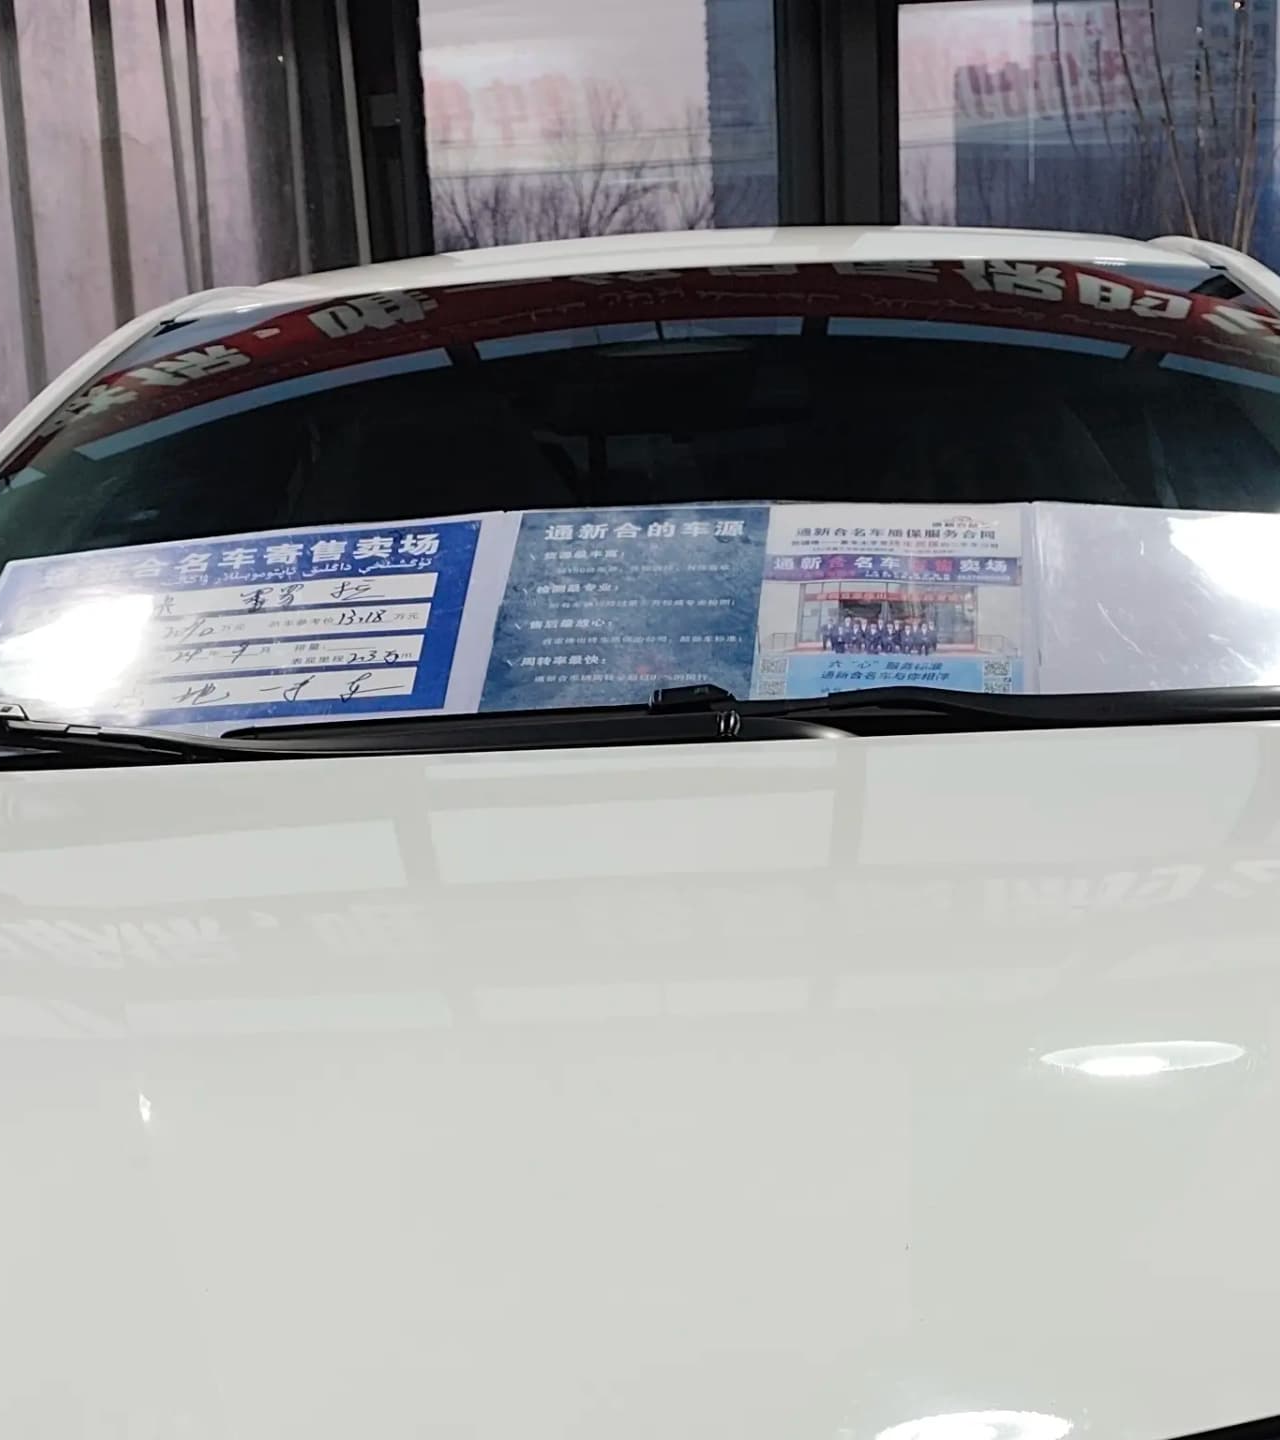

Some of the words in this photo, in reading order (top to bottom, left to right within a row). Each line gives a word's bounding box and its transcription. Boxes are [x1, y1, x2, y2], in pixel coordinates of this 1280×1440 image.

[544, 519, 745, 541] 通新合的车源
